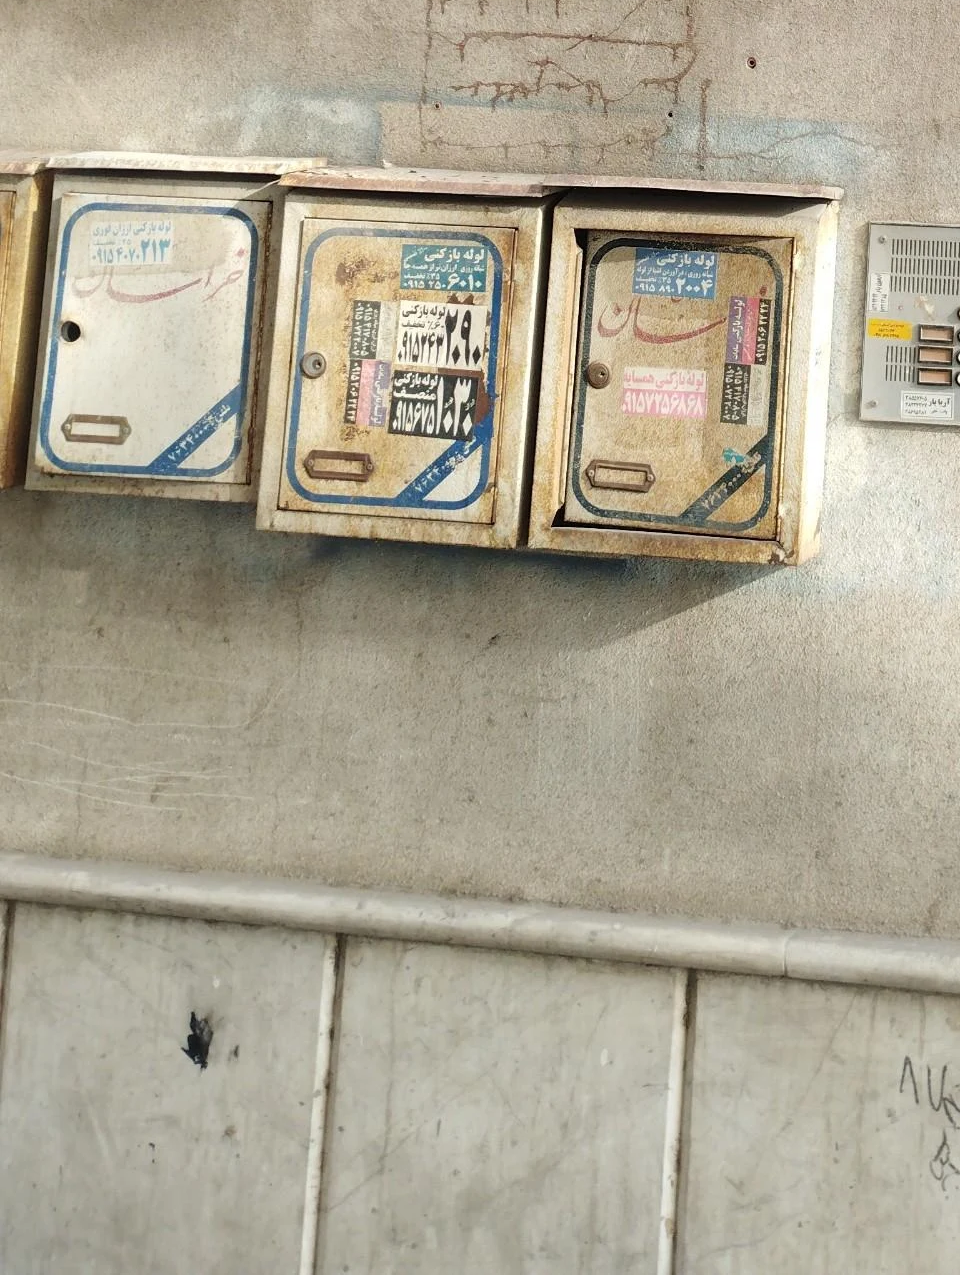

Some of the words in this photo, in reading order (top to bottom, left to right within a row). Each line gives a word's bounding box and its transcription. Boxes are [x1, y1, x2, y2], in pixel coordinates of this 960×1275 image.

[463, 248, 485, 263] لوله
[694, 254, 715, 269] لوله
[430, 306, 446, 319] لوله
[422, 373, 438, 389] لوله
